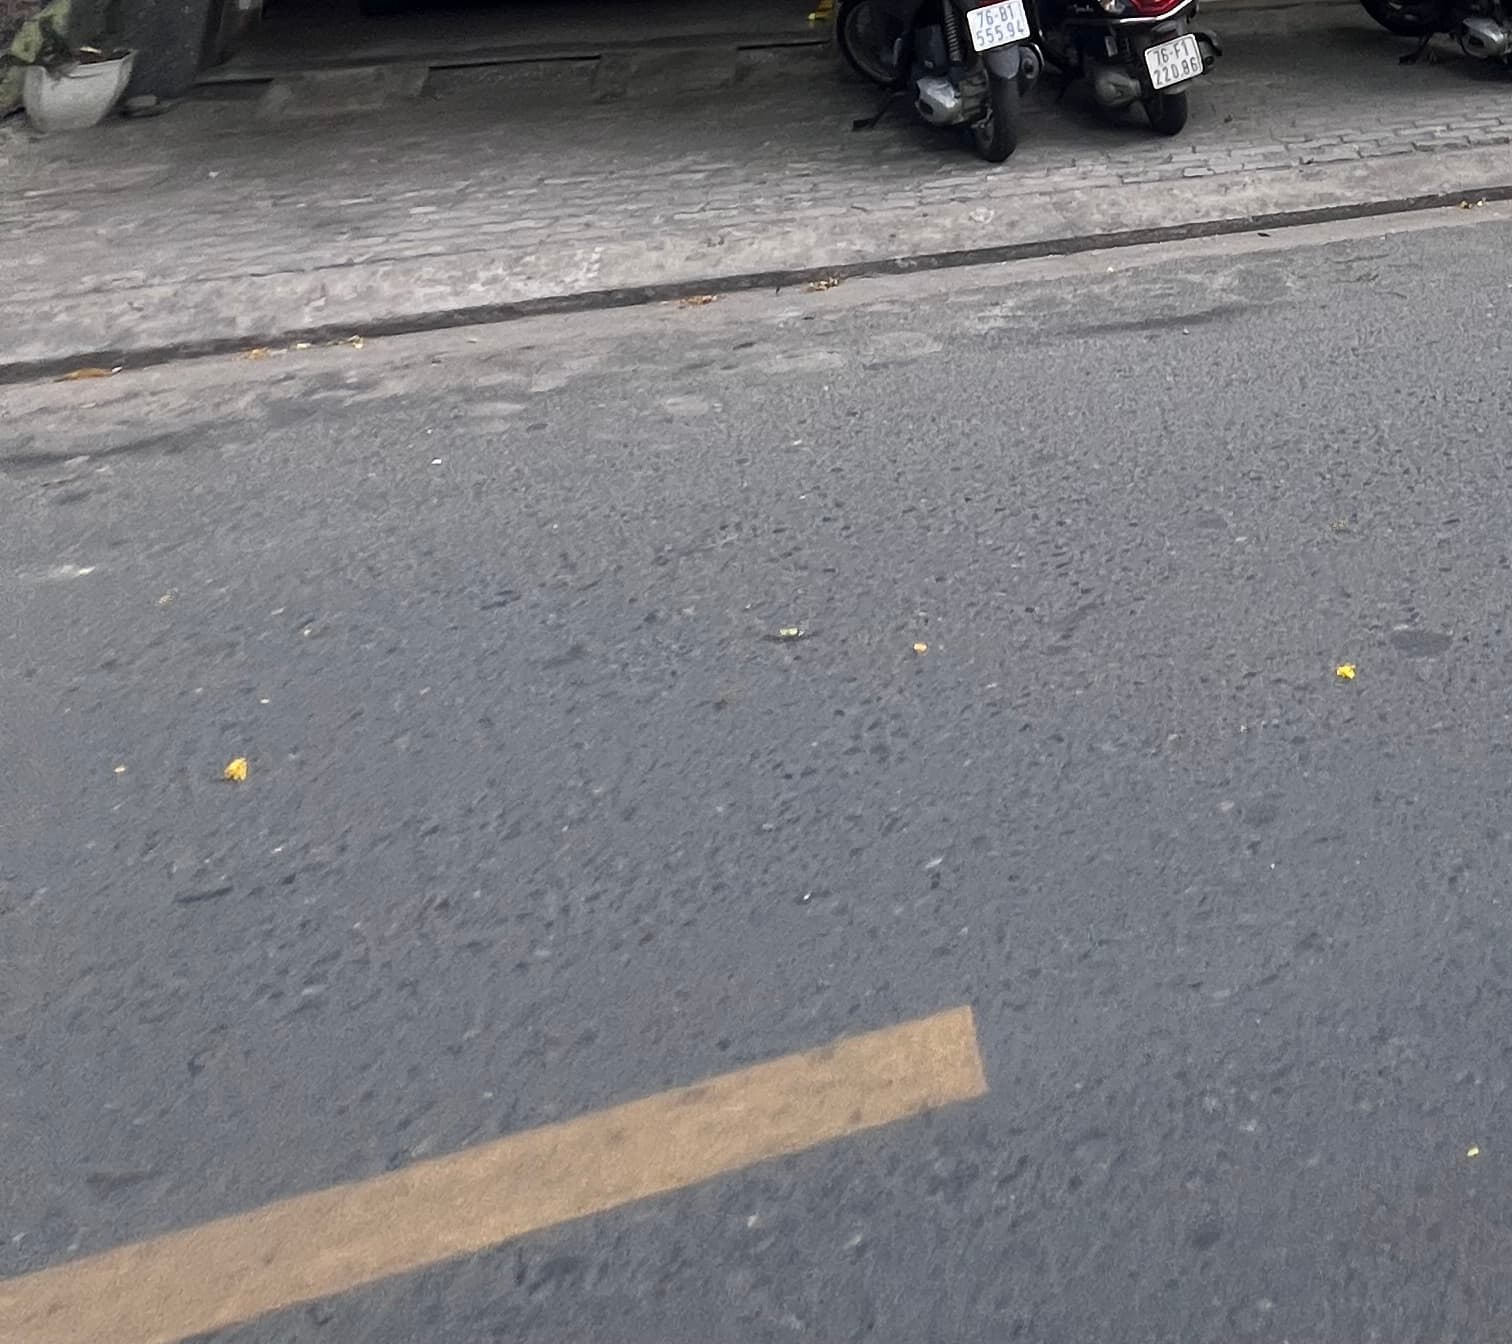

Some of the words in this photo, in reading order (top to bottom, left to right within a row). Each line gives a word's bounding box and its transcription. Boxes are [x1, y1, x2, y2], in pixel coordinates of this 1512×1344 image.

[976, 4, 1015, 29] 76-B1
[975, 18, 1025, 48] 555.94
[1152, 38, 1190, 66] 76-F1
[1153, 56, 1199, 86] 220.86
